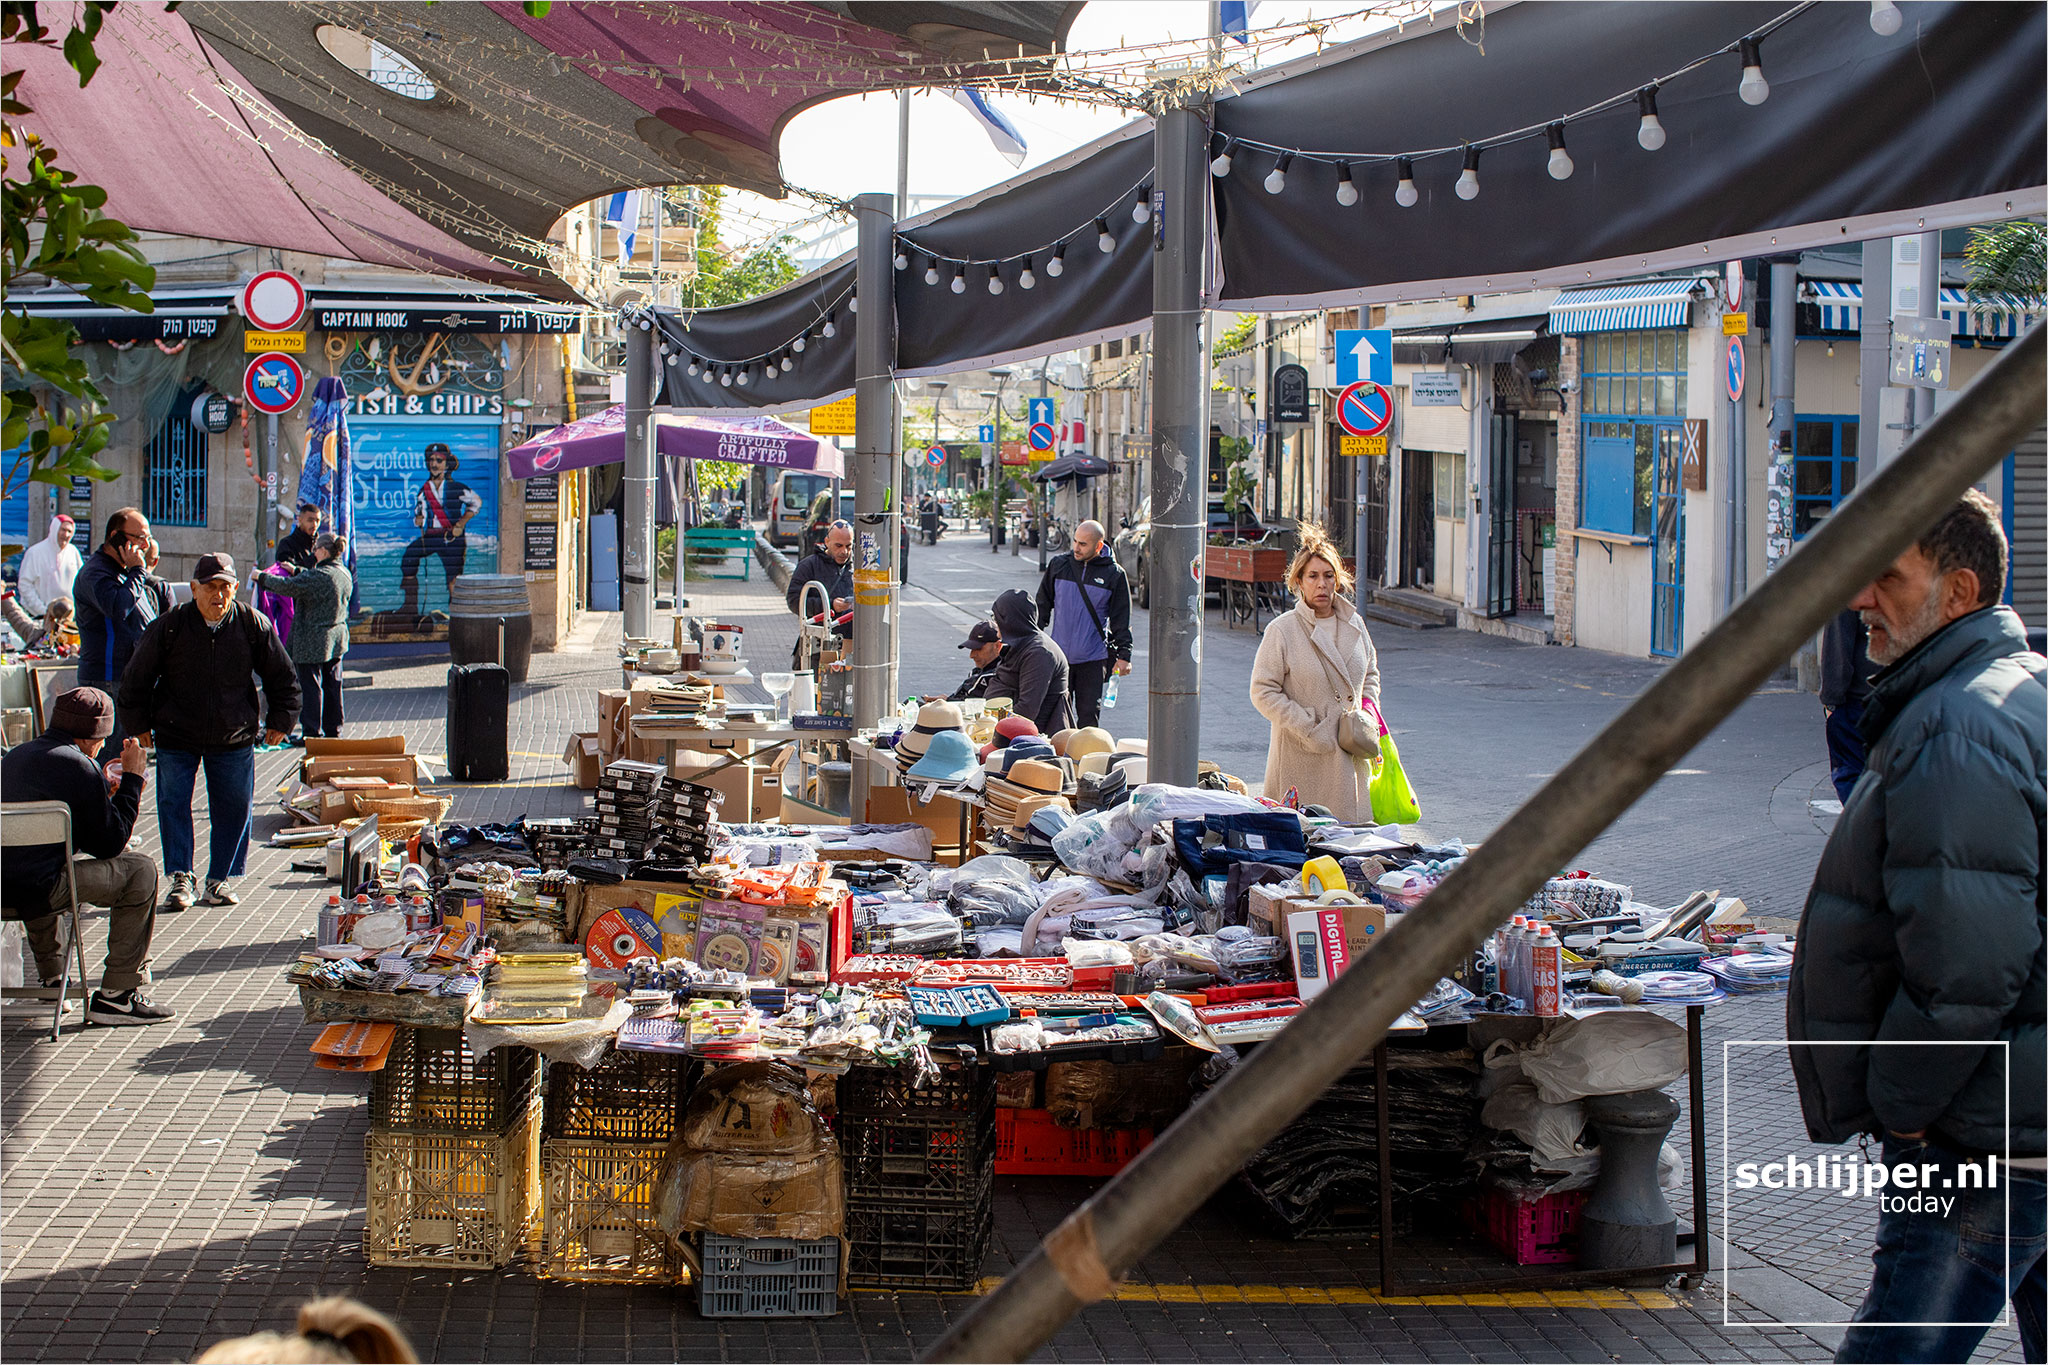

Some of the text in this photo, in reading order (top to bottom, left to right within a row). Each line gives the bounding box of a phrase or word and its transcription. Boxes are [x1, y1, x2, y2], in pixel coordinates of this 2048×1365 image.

[163, 318, 217, 337] קפטן הוק
[322, 311, 409, 328] CAPTAIN HOOK
[500, 313, 574, 333] קפטן הוק
[250, 336, 301, 346] כולל דו גלגלי
[403, 395, 424, 414] &
[430, 394, 503, 414] CHIPS
[209, 411, 228, 422] HOOK
[718, 434, 789, 450] ARTFULLY
[352, 432, 426, 477] Captain
[717, 443, 790, 465] CRAFTED.
[354, 472, 420, 509] Hook
[1324, 913, 1344, 980] DIGITAL
[591, 944, 618, 970] OLLEN
[1533, 971, 1556, 987] GAS
